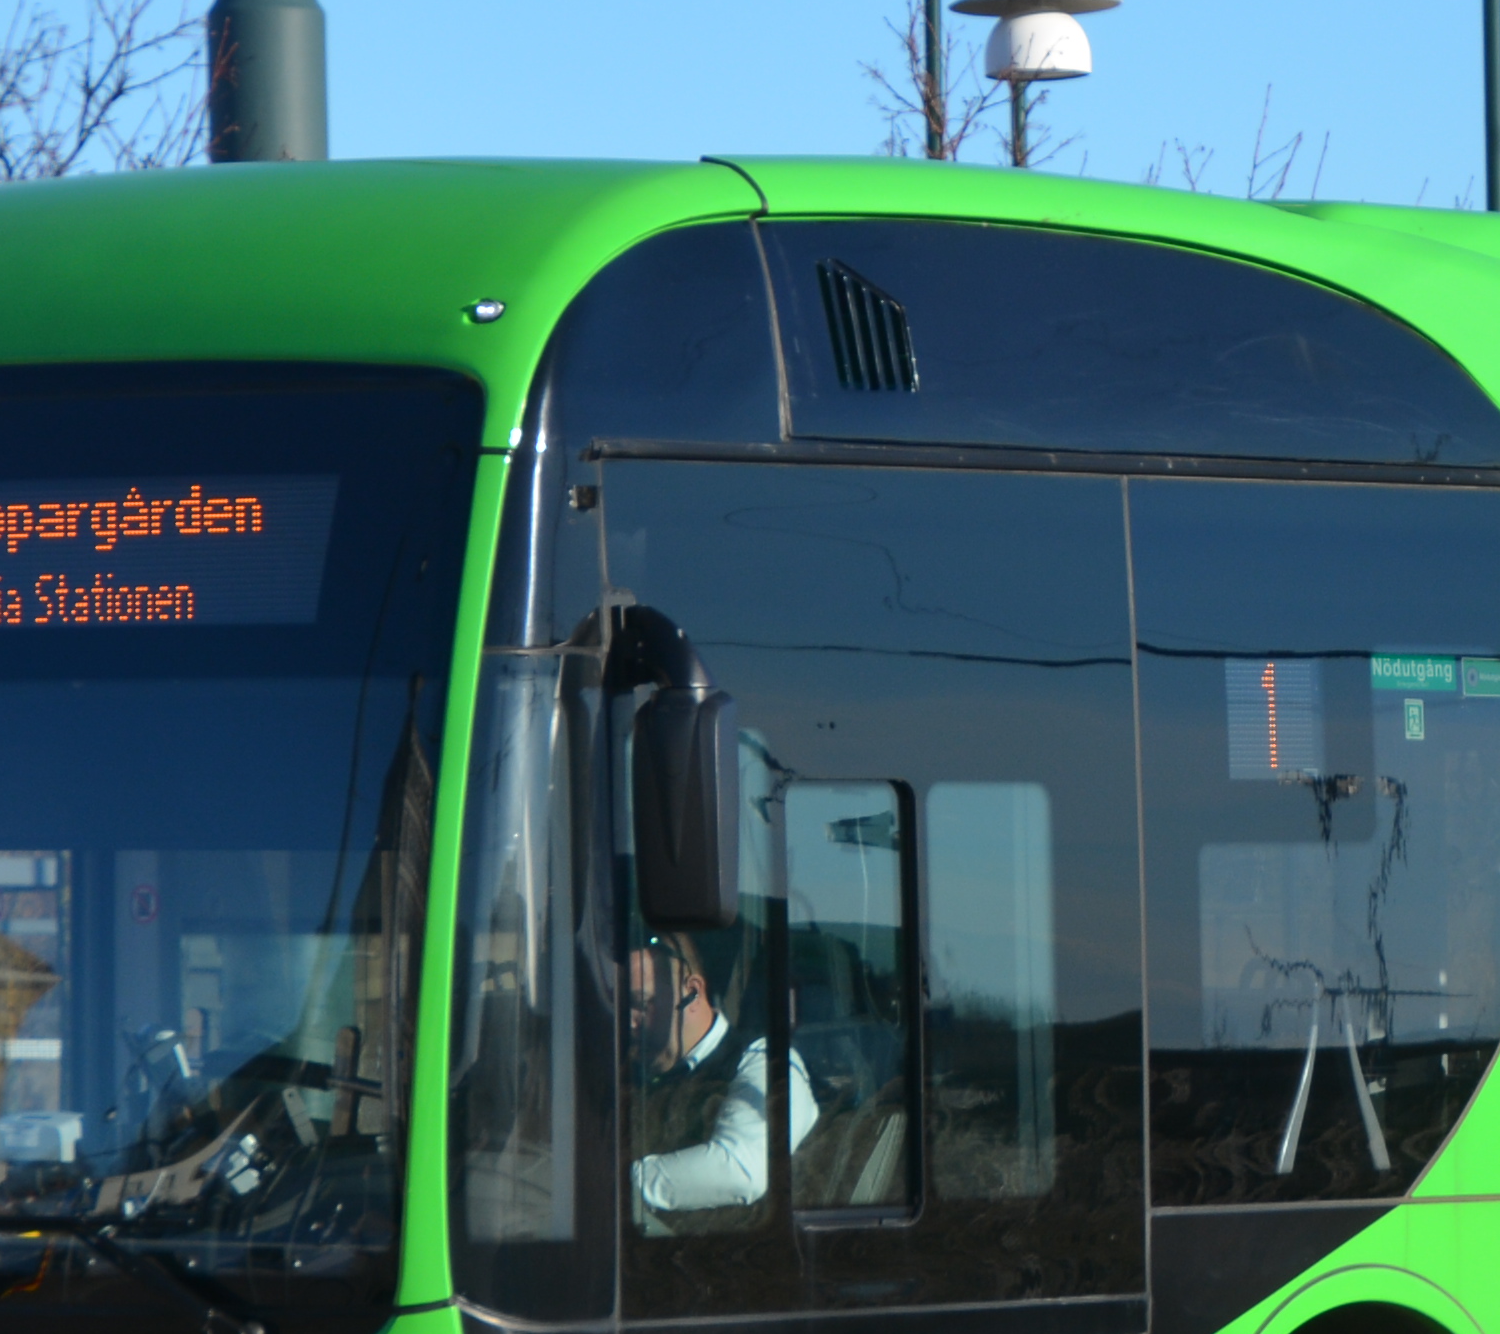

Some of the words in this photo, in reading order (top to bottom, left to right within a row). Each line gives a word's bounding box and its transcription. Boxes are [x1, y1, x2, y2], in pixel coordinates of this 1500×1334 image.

[34, 572, 194, 623] Stationen
[1371, 657, 1453, 683] Nödutgång
[1261, 663, 1278, 768] 1
